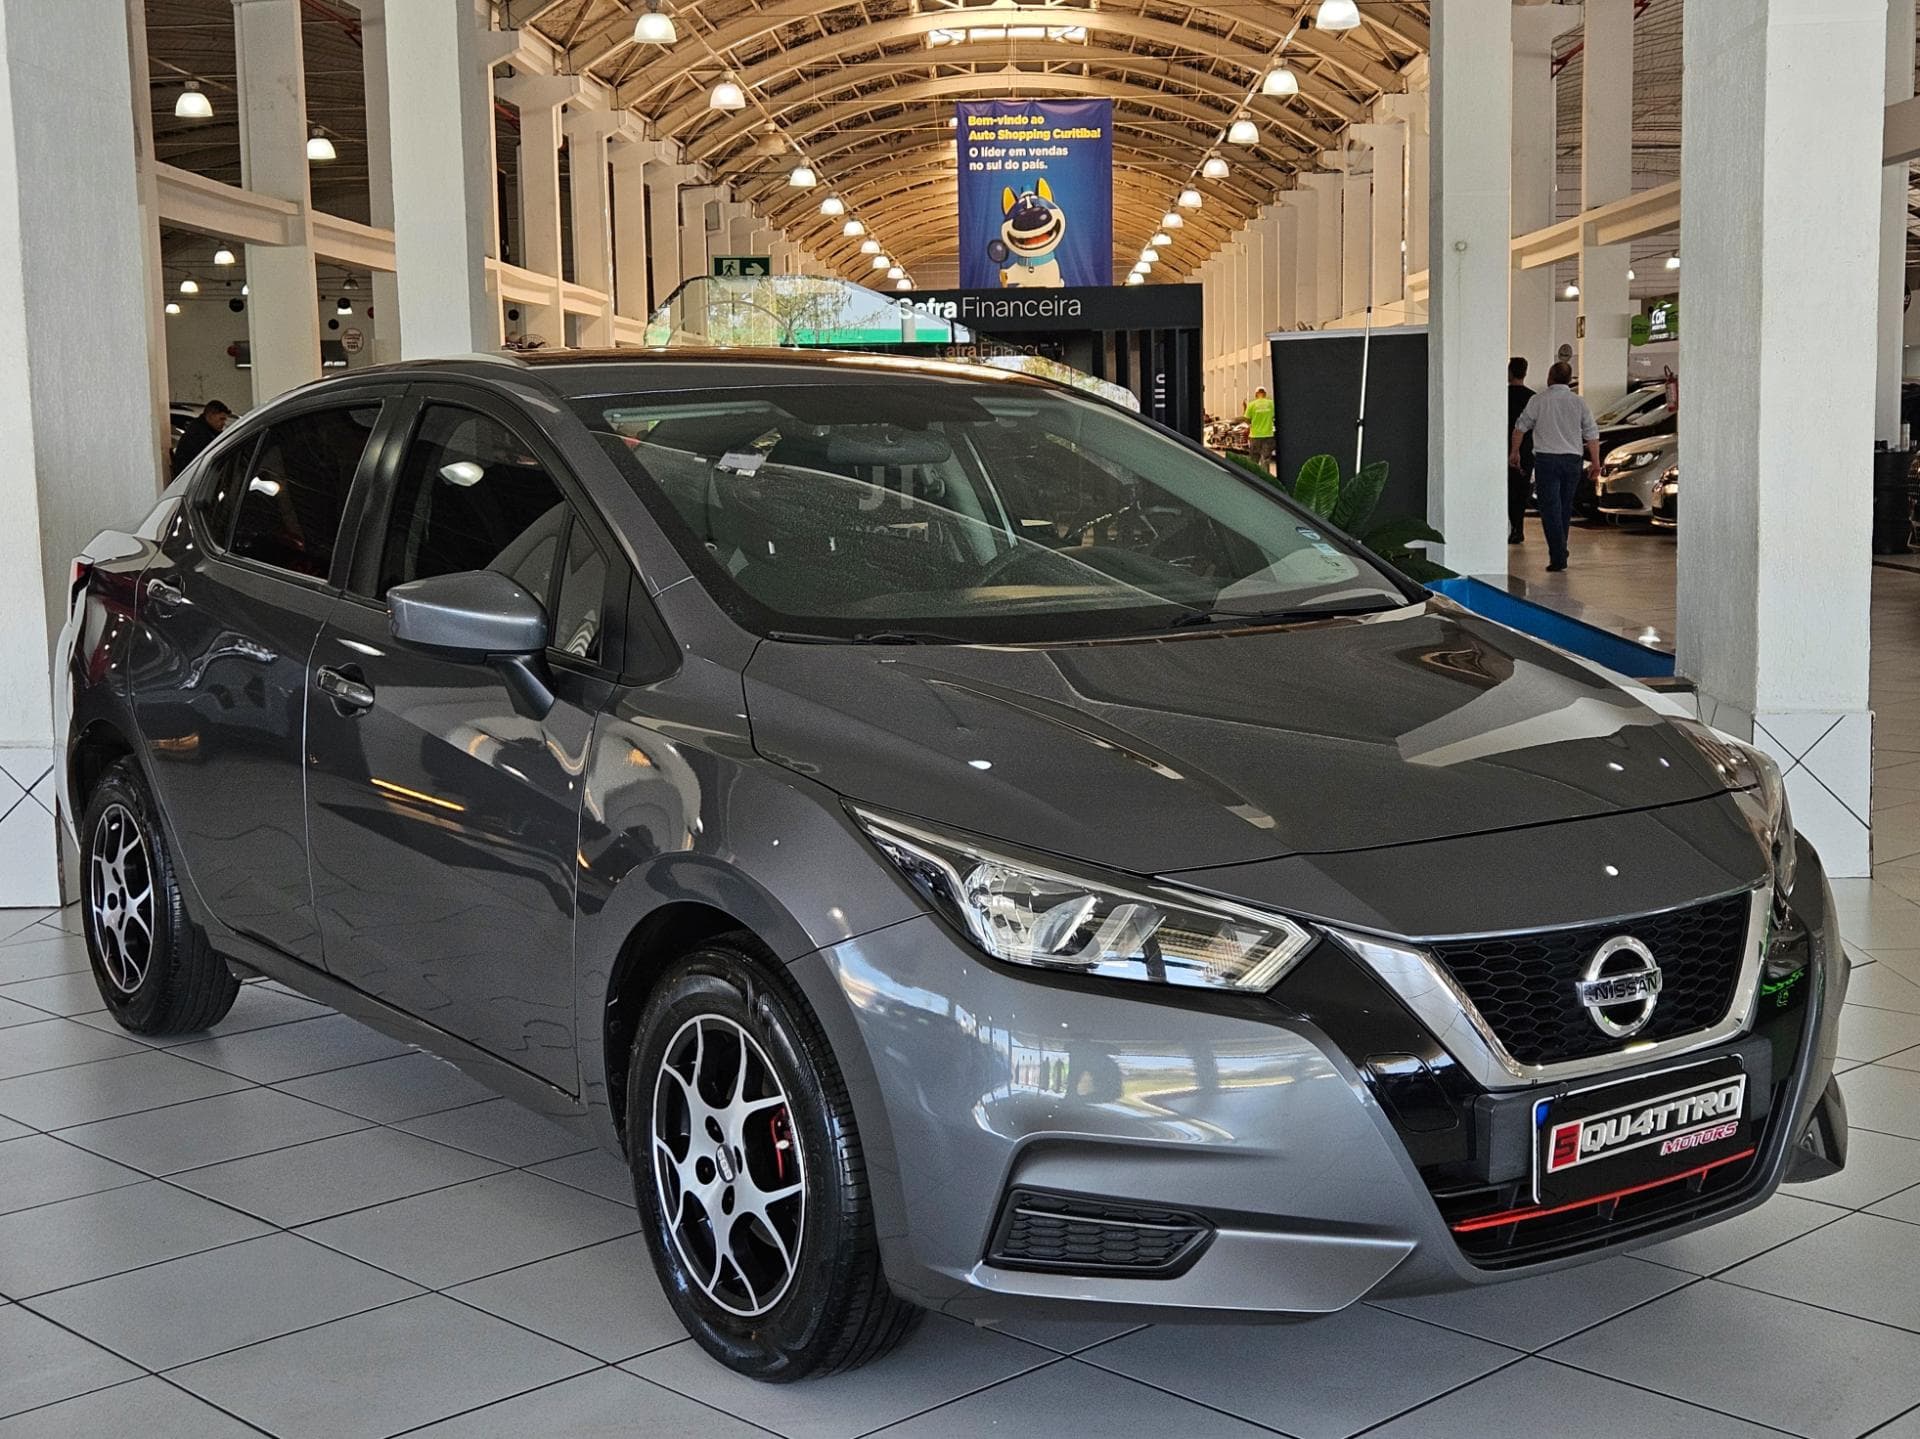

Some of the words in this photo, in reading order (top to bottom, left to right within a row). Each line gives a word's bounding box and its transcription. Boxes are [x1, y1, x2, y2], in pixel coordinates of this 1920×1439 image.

[968, 115, 1028, 126] Bem-vindo
[1030, 117, 1045, 125] ao
[968, 130, 996, 141] Auto
[997, 129, 1050, 141] Shopping
[1052, 128, 1102, 139] Curitiba!
[969, 147, 978, 158] O
[981, 146, 1006, 157] líder
[1008, 148, 1026, 156] em
[1029, 145, 1068, 156] vendas
[969, 162, 984, 171] no
[986, 159, 1002, 170] sul
[1004, 159, 1020, 170] do
[1022, 159, 1048, 171] país.
[898, 297, 957, 319] Safra
[962, 296, 1081, 318] Financeira
[1594, 971, 1658, 1000] NISSAN
[1660, 1121, 1739, 1156] MOTORS
